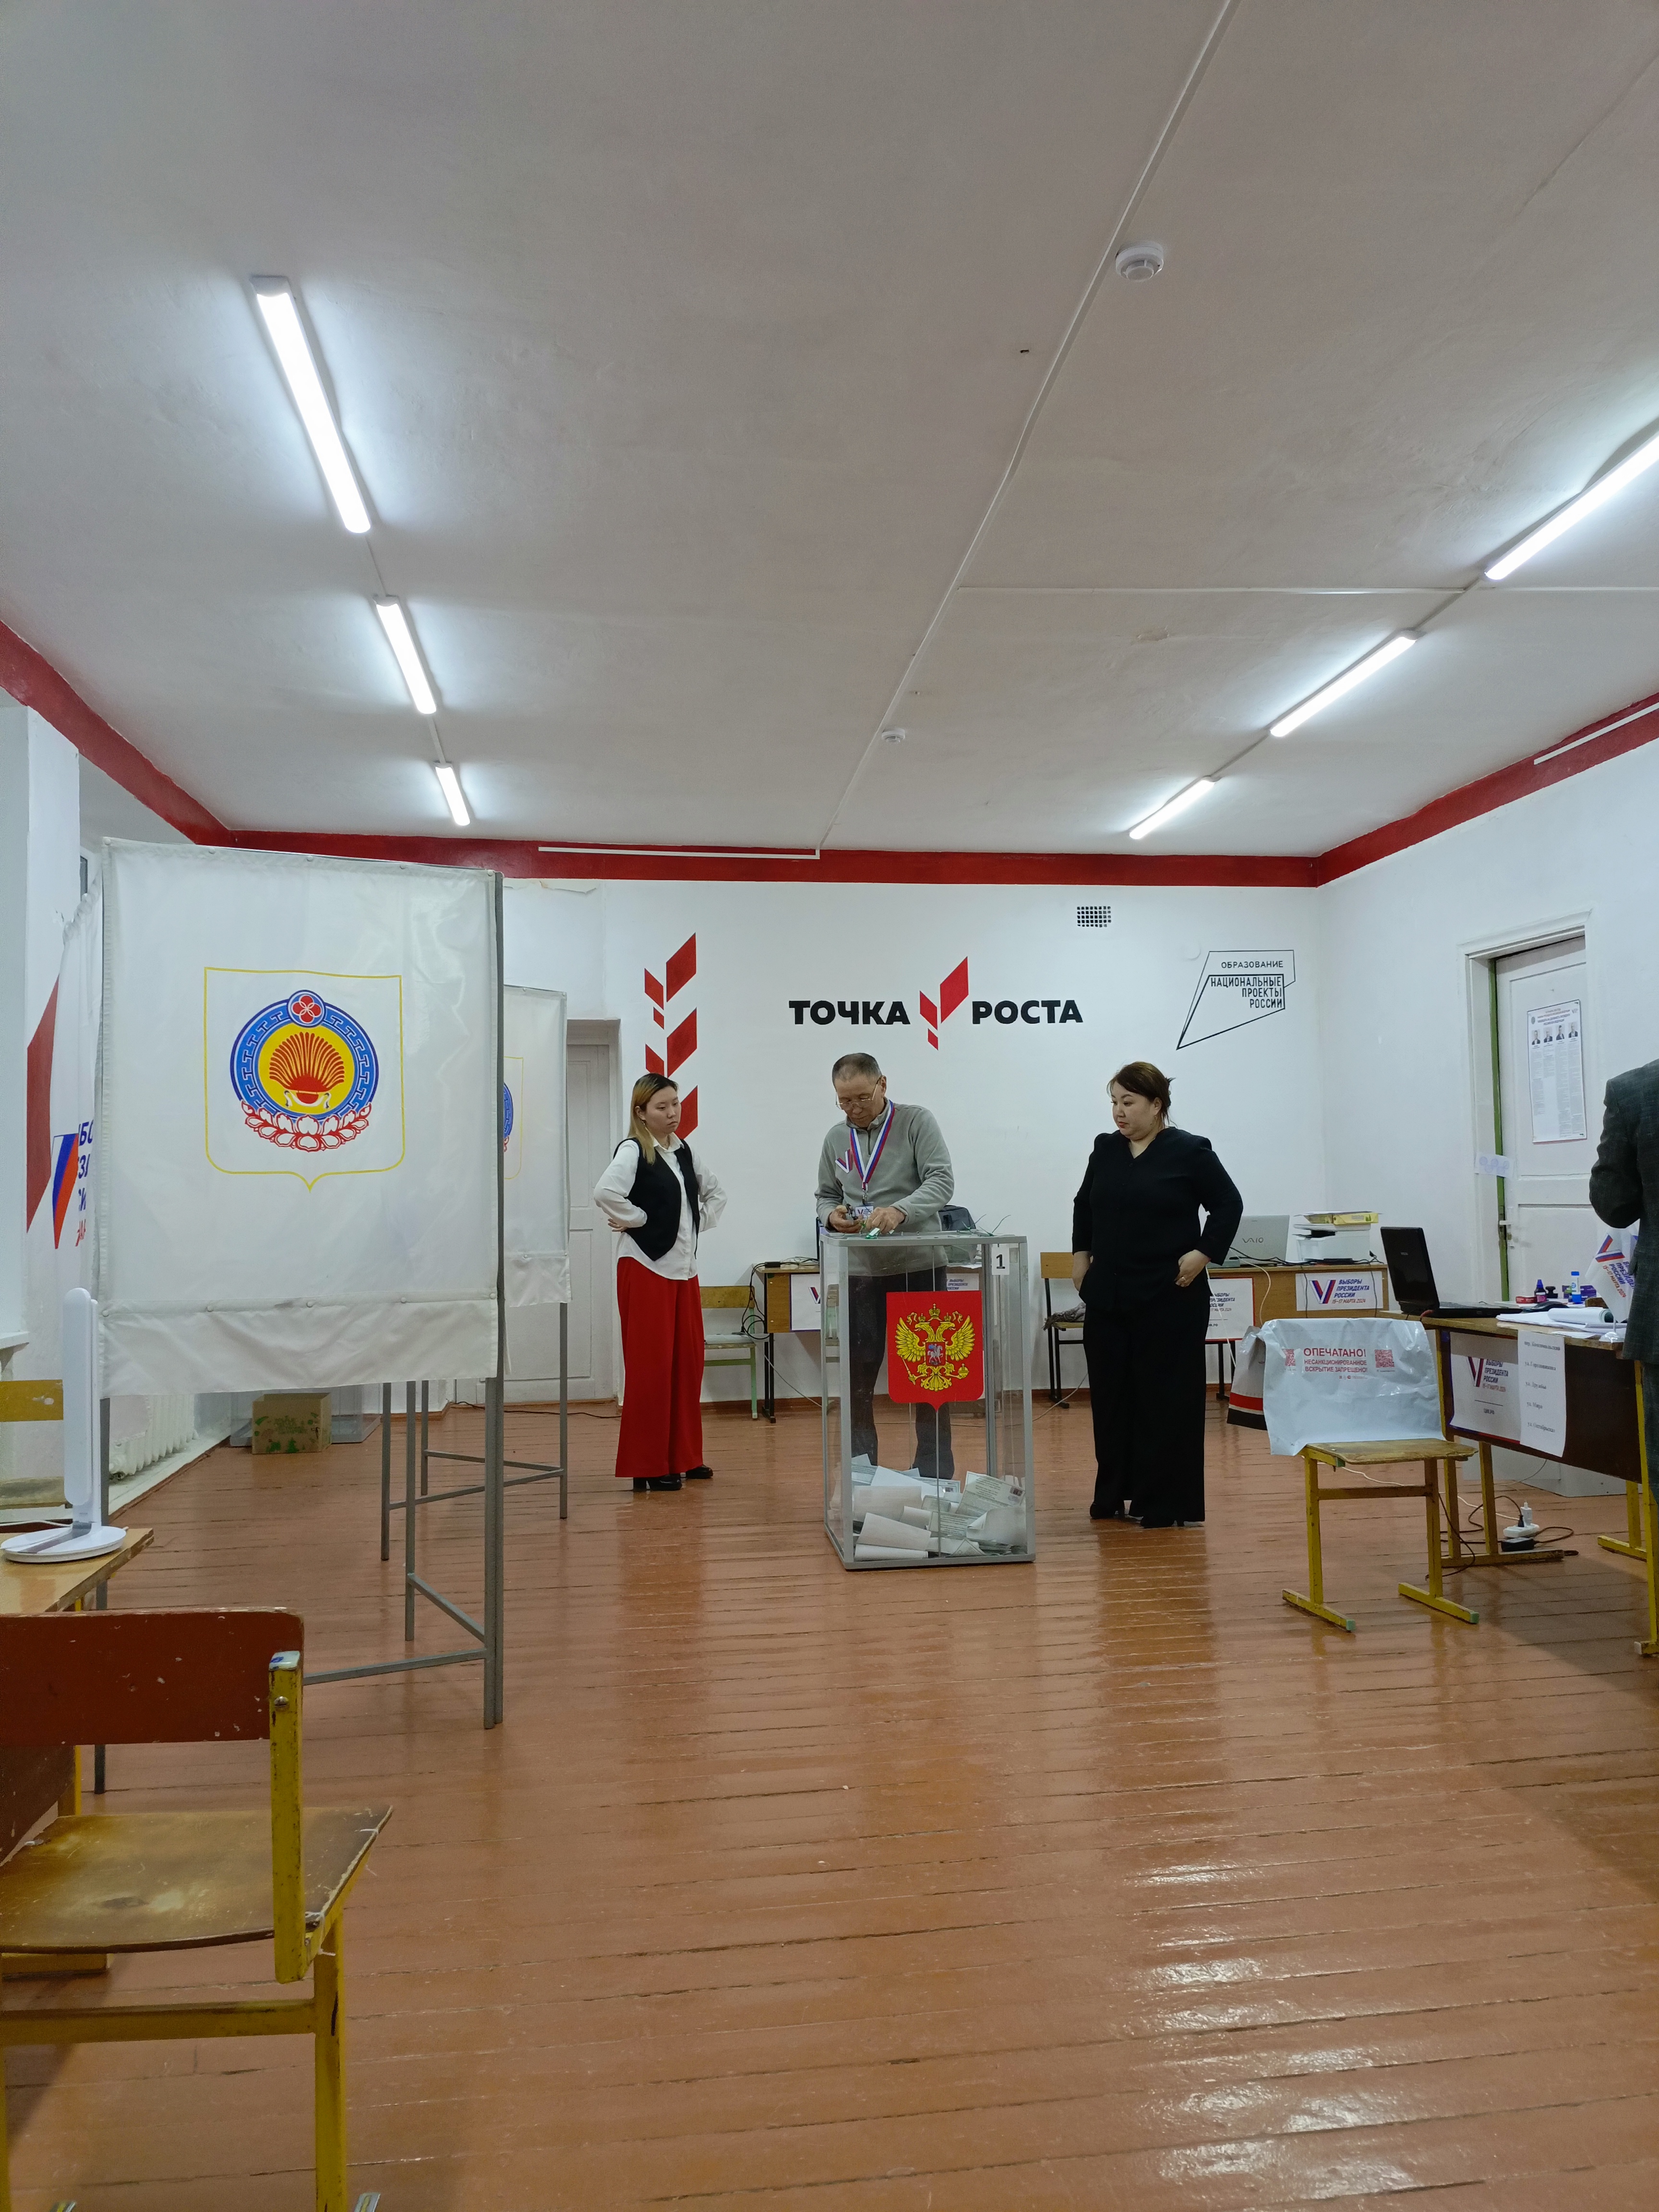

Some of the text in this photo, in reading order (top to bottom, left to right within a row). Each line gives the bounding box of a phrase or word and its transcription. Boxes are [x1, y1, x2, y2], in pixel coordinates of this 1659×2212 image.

[1211, 976, 1281, 988] НАЦИОНАЛЬНЫЕ
[1242, 987, 1282, 998] ПРОЕКТЫ
[1250, 998, 1282, 1008] РОССИИ
[789, 1000, 1083, 1025] ТОЧКА РОСТА
[996, 1254, 1005, 1269] 1
[1609, 1263, 1625, 1285] РОССИИ
[1303, 1348, 1366, 1357] ОПЕЧАТАНО!
[1484, 1367, 1508, 1377] ПРЕЗИДЕНТА
